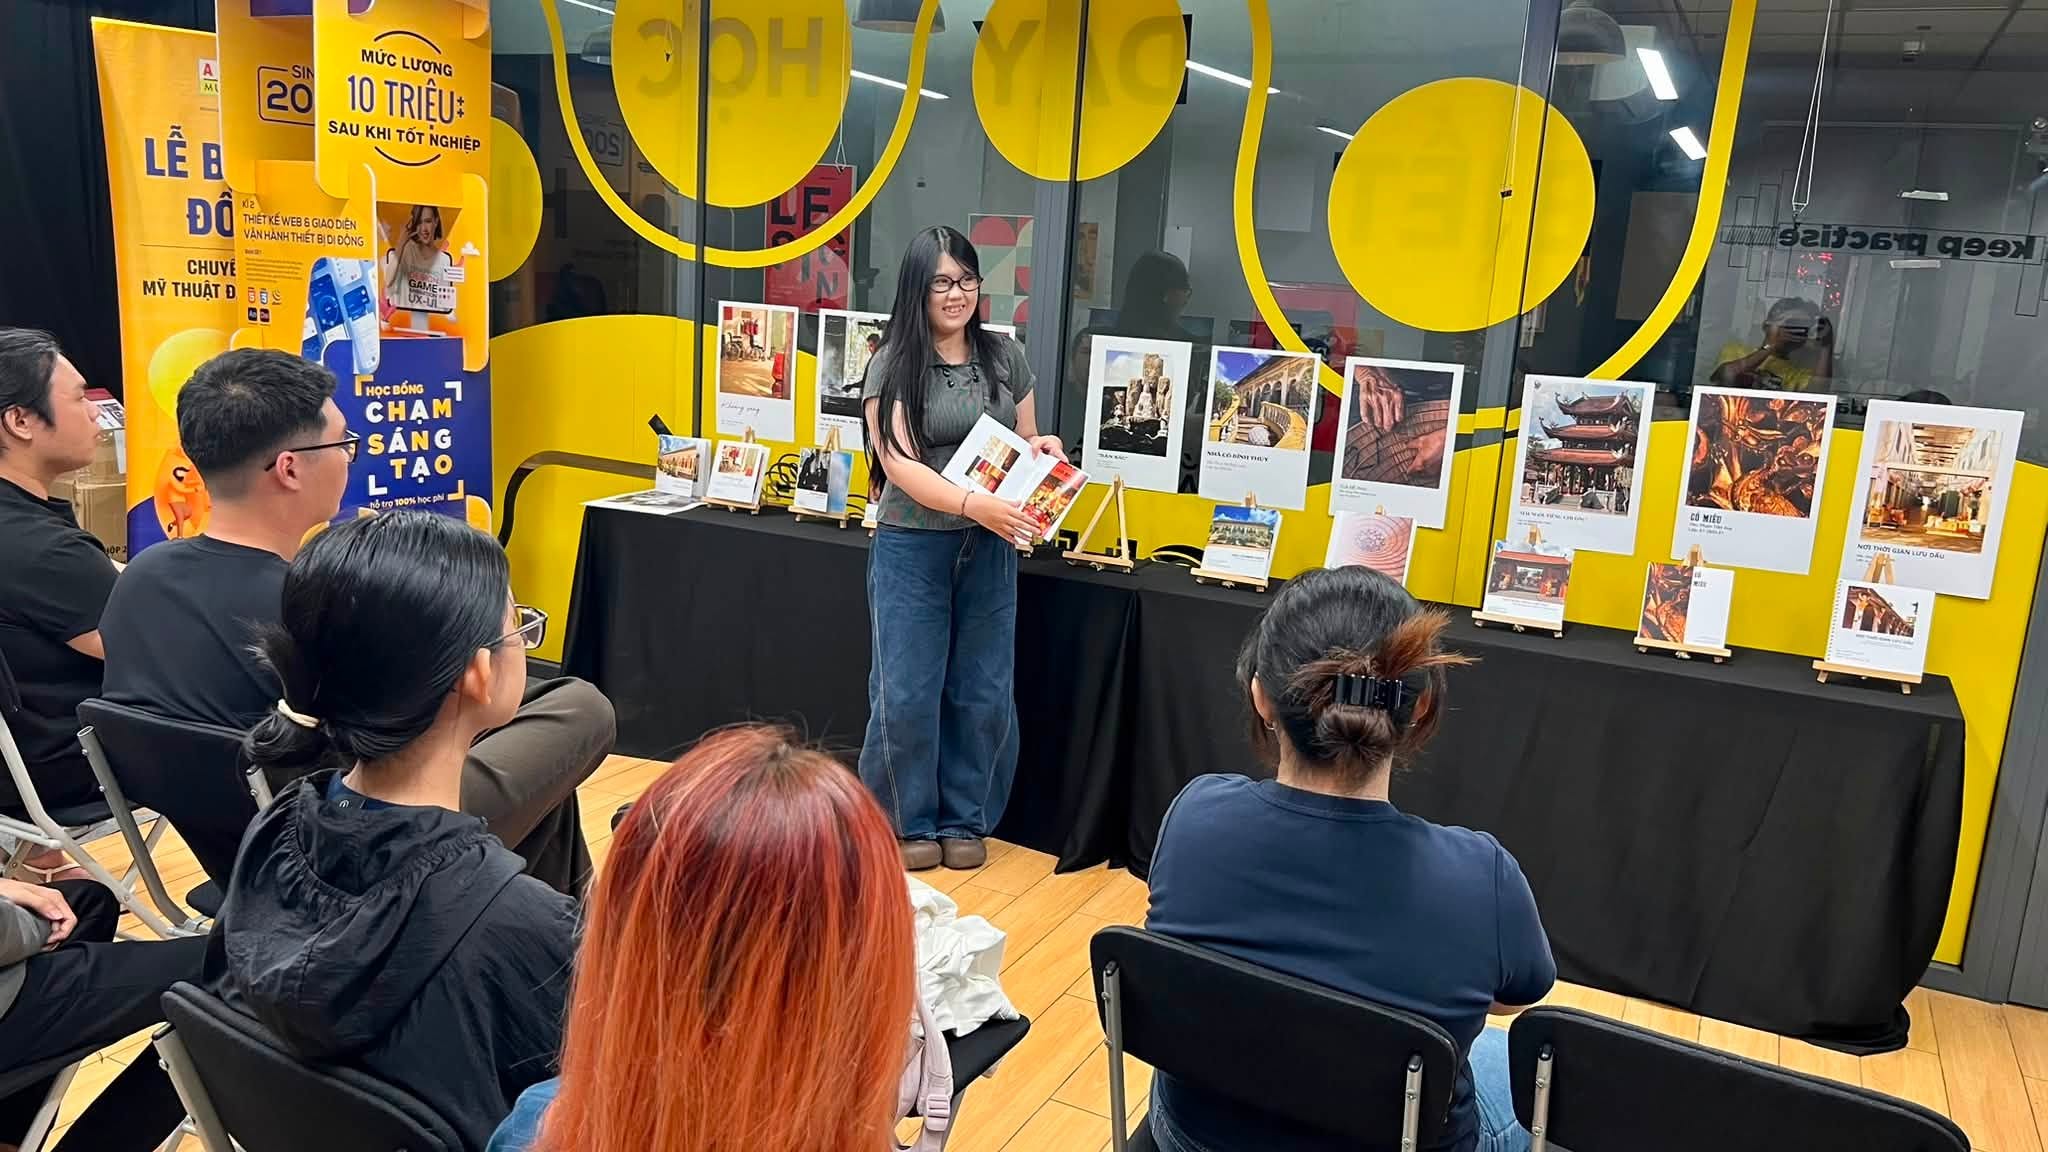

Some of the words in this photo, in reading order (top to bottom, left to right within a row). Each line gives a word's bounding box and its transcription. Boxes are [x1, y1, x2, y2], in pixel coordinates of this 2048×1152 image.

[291, 64, 314, 79] SIN
[361, 48, 397, 67] MỨC
[402, 56, 453, 77] LƯƠNG
[266, 80, 313, 114] 20
[347, 75, 375, 113] 10
[328, 120, 360, 136] SAU
[365, 125, 391, 141] KHI
[396, 126, 425, 145] TỐT
[429, 133, 481, 154] NGHIỆP
[144, 125, 189, 178] LỄ
[243, 211, 267, 225] THIẾT
[268, 211, 281, 226] KẾ
[281, 216, 302, 227] WEB
[303, 217, 310, 228] &
[311, 218, 335, 230] GIAO
[291, 229, 315, 244] THIẾT
[327, 234, 337, 245] DI
[337, 234, 364, 248] ĐỘNG
[142, 278, 167, 297] MỸ
[172, 280, 221, 301] THUẬT
[225, 284, 236, 300] Đ
[408, 278, 438, 294] GAME
[366, 385, 391, 399] HỌC
[365, 398, 452, 425] CHẠM
[367, 426, 452, 455] SÁNG
[389, 454, 453, 483] TẠO
[394, 497, 417, 507] 100%
[1857, 542, 1872, 551] NƠI
